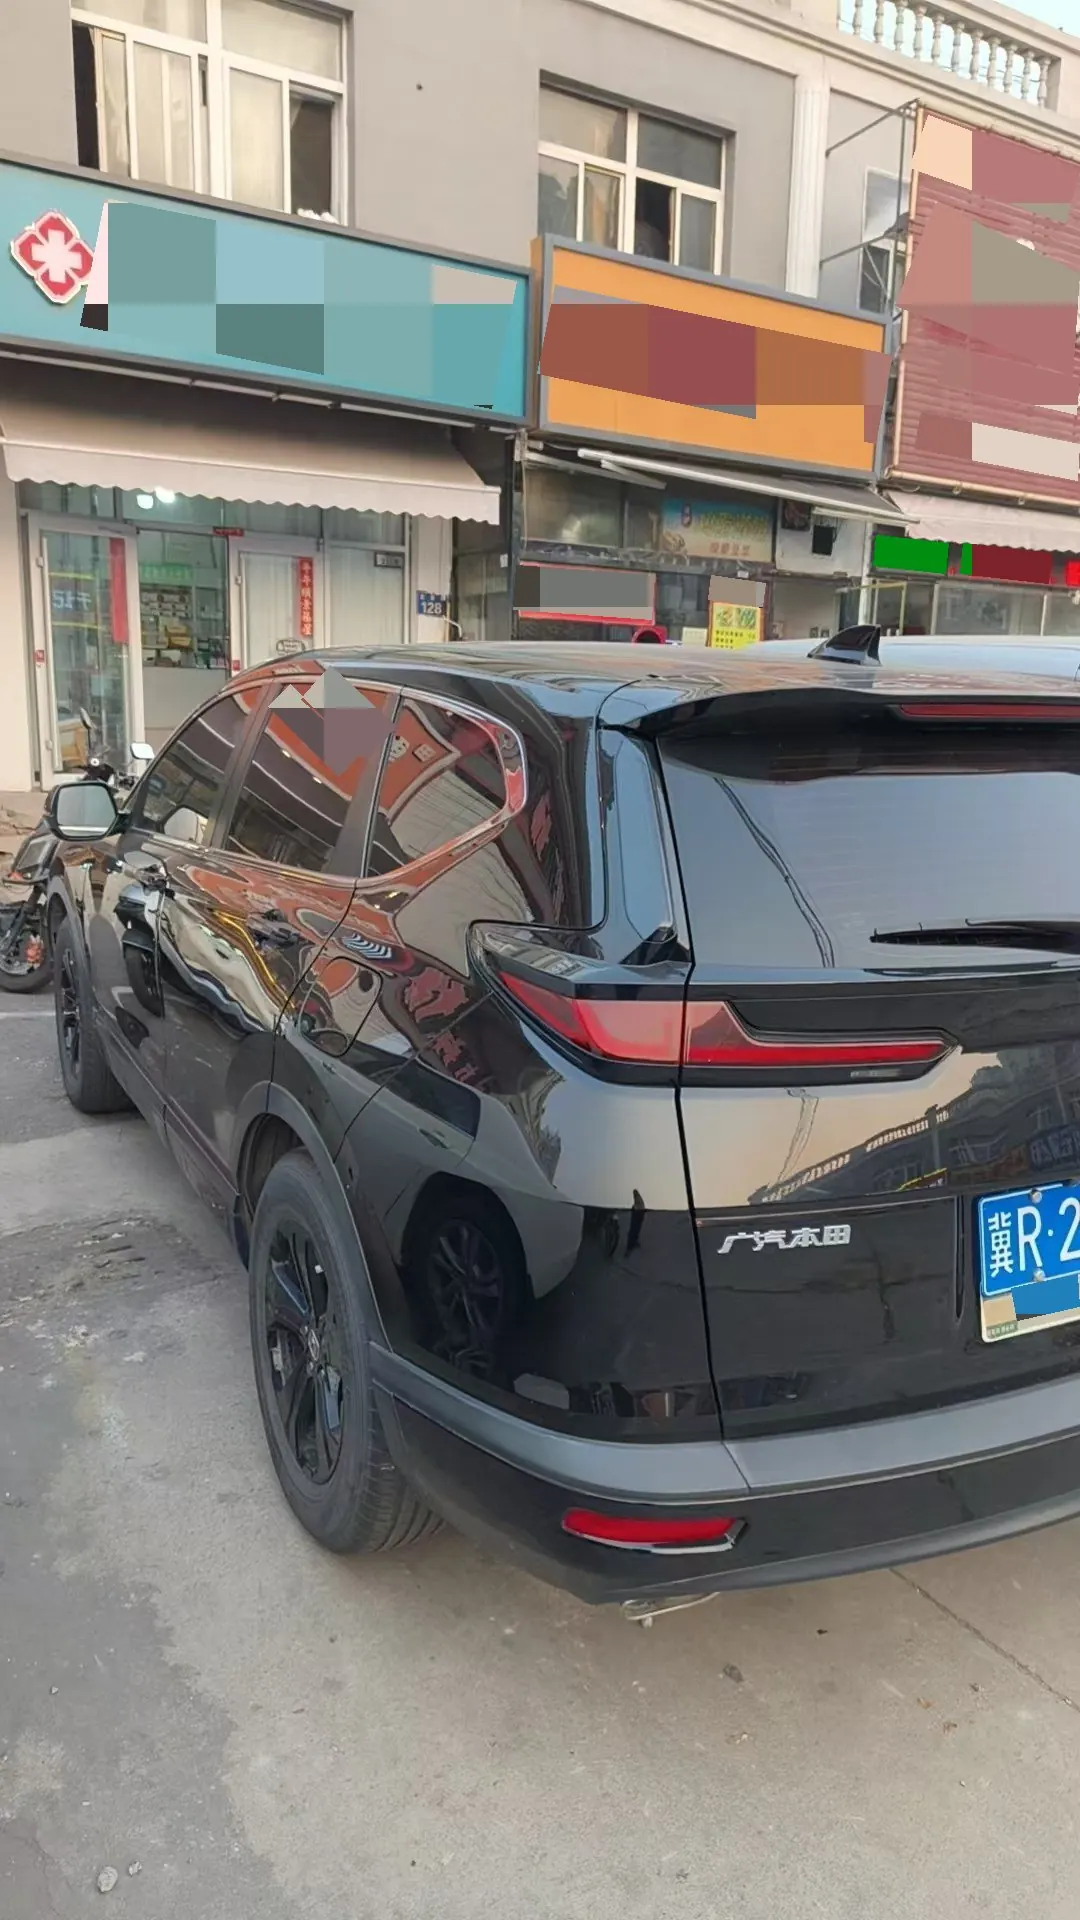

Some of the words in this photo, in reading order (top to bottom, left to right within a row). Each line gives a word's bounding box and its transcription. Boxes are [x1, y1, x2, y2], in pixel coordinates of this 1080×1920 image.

[421, 601, 442, 614] 128
[717, 1224, 851, 1254] 广汽本田
